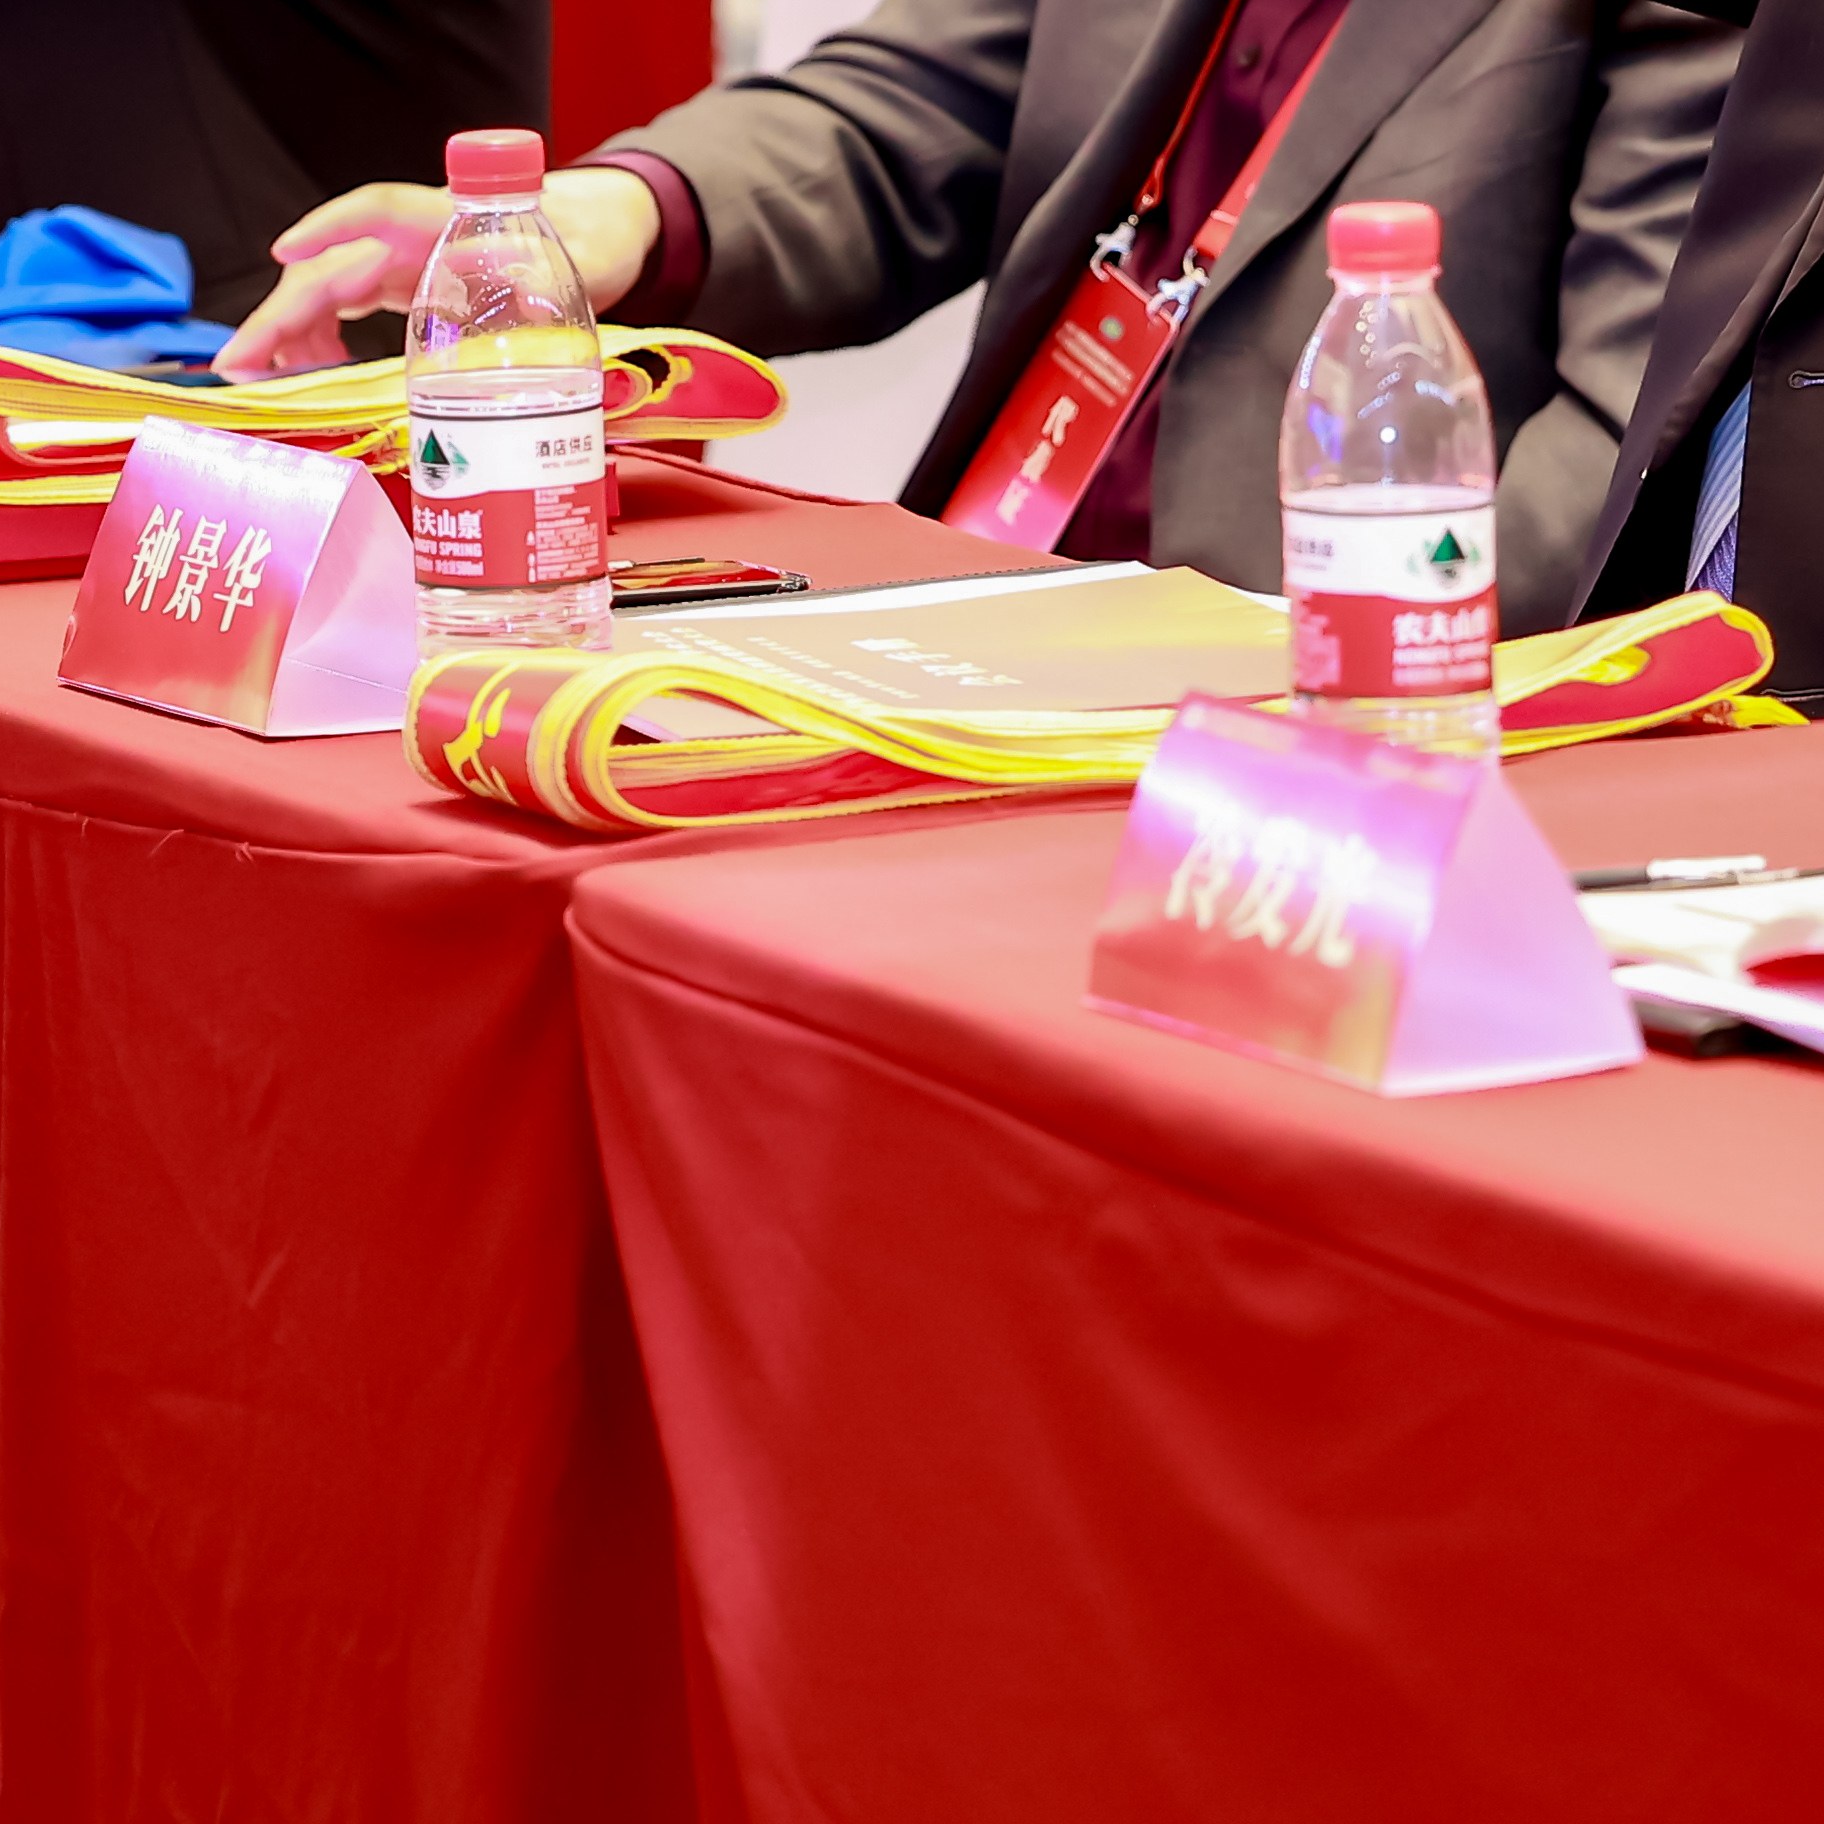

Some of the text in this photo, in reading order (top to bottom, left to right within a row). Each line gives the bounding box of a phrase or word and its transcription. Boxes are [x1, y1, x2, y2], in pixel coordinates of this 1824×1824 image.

[124, 503, 273, 633] 钟景华
[439, 541, 482, 558] SPRING
